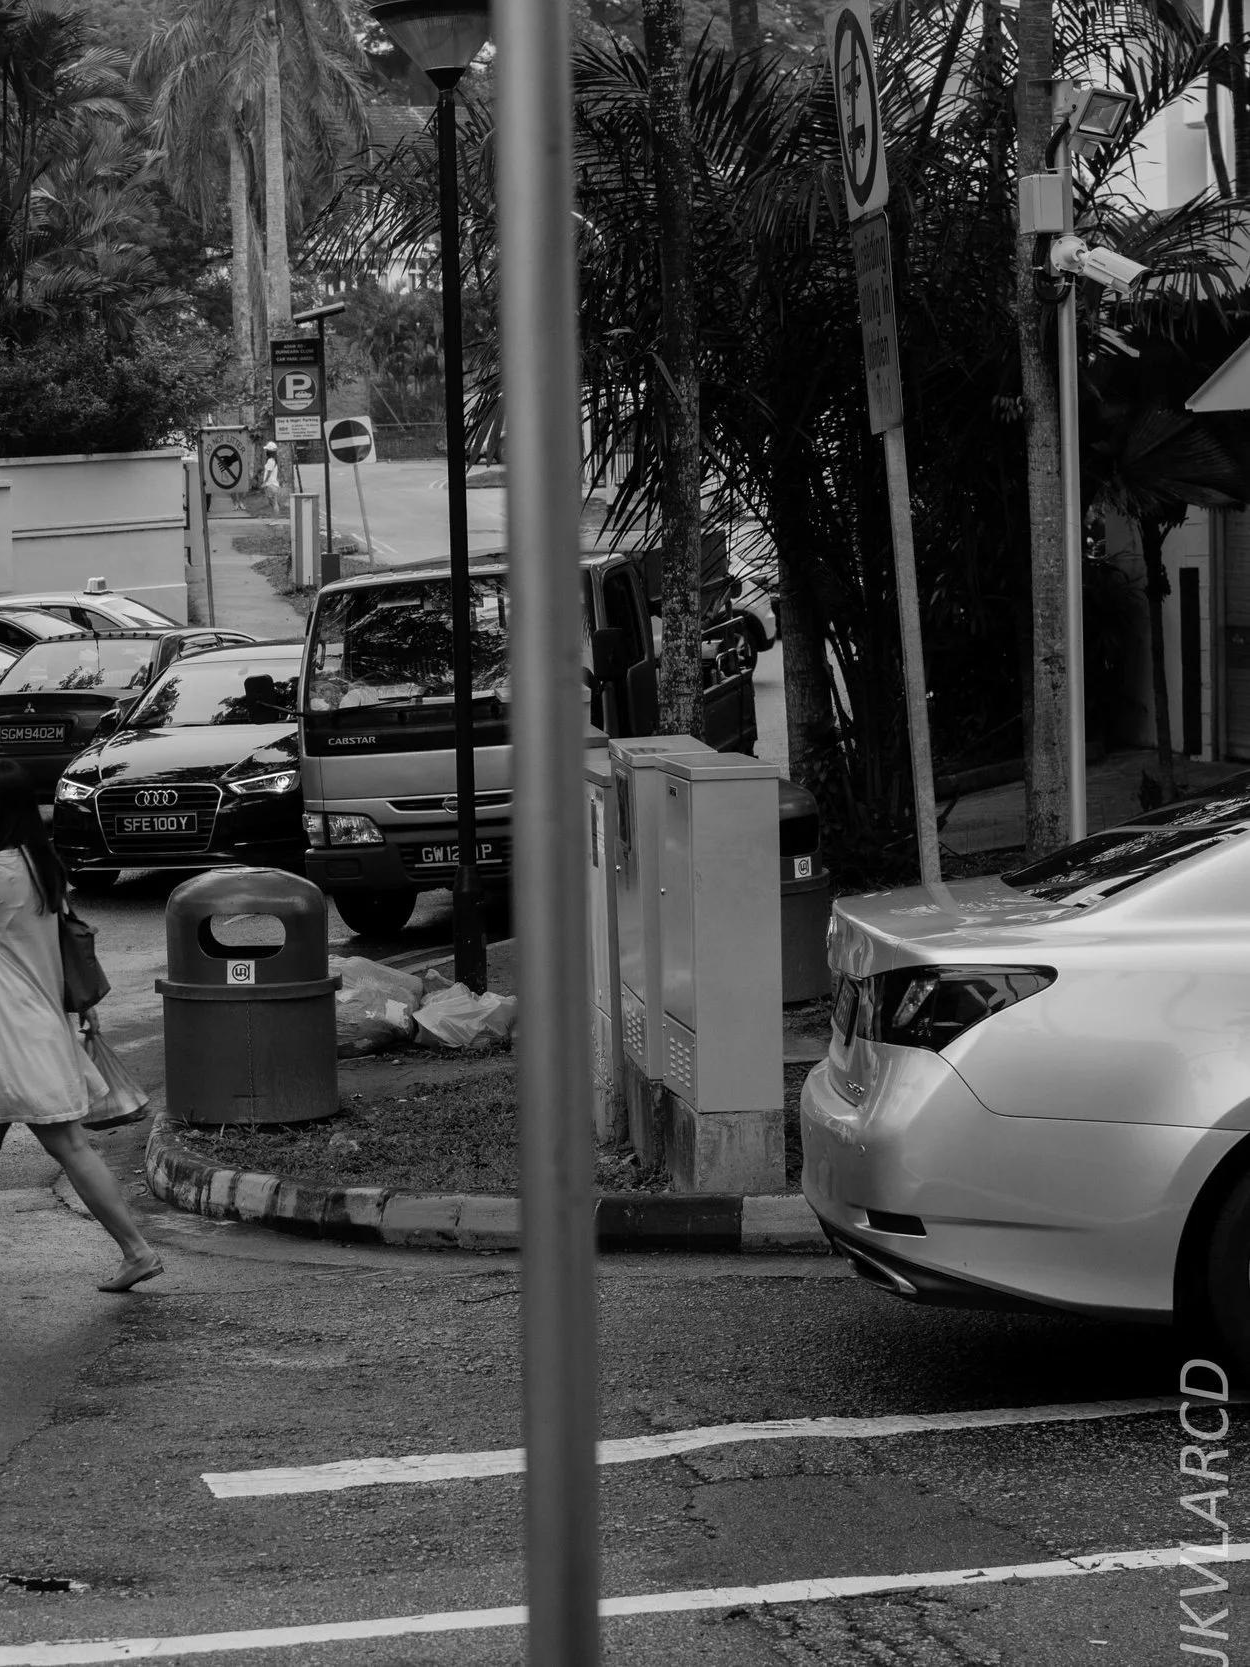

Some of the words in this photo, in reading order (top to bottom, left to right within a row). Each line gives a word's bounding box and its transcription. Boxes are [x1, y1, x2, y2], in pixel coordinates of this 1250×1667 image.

[285, 374, 313, 399] P
[204, 443, 213, 457] DO
[212, 434, 224, 444] NOT
[226, 434, 246, 455] LITTER
[327, 736, 377, 746] CABSTAR
